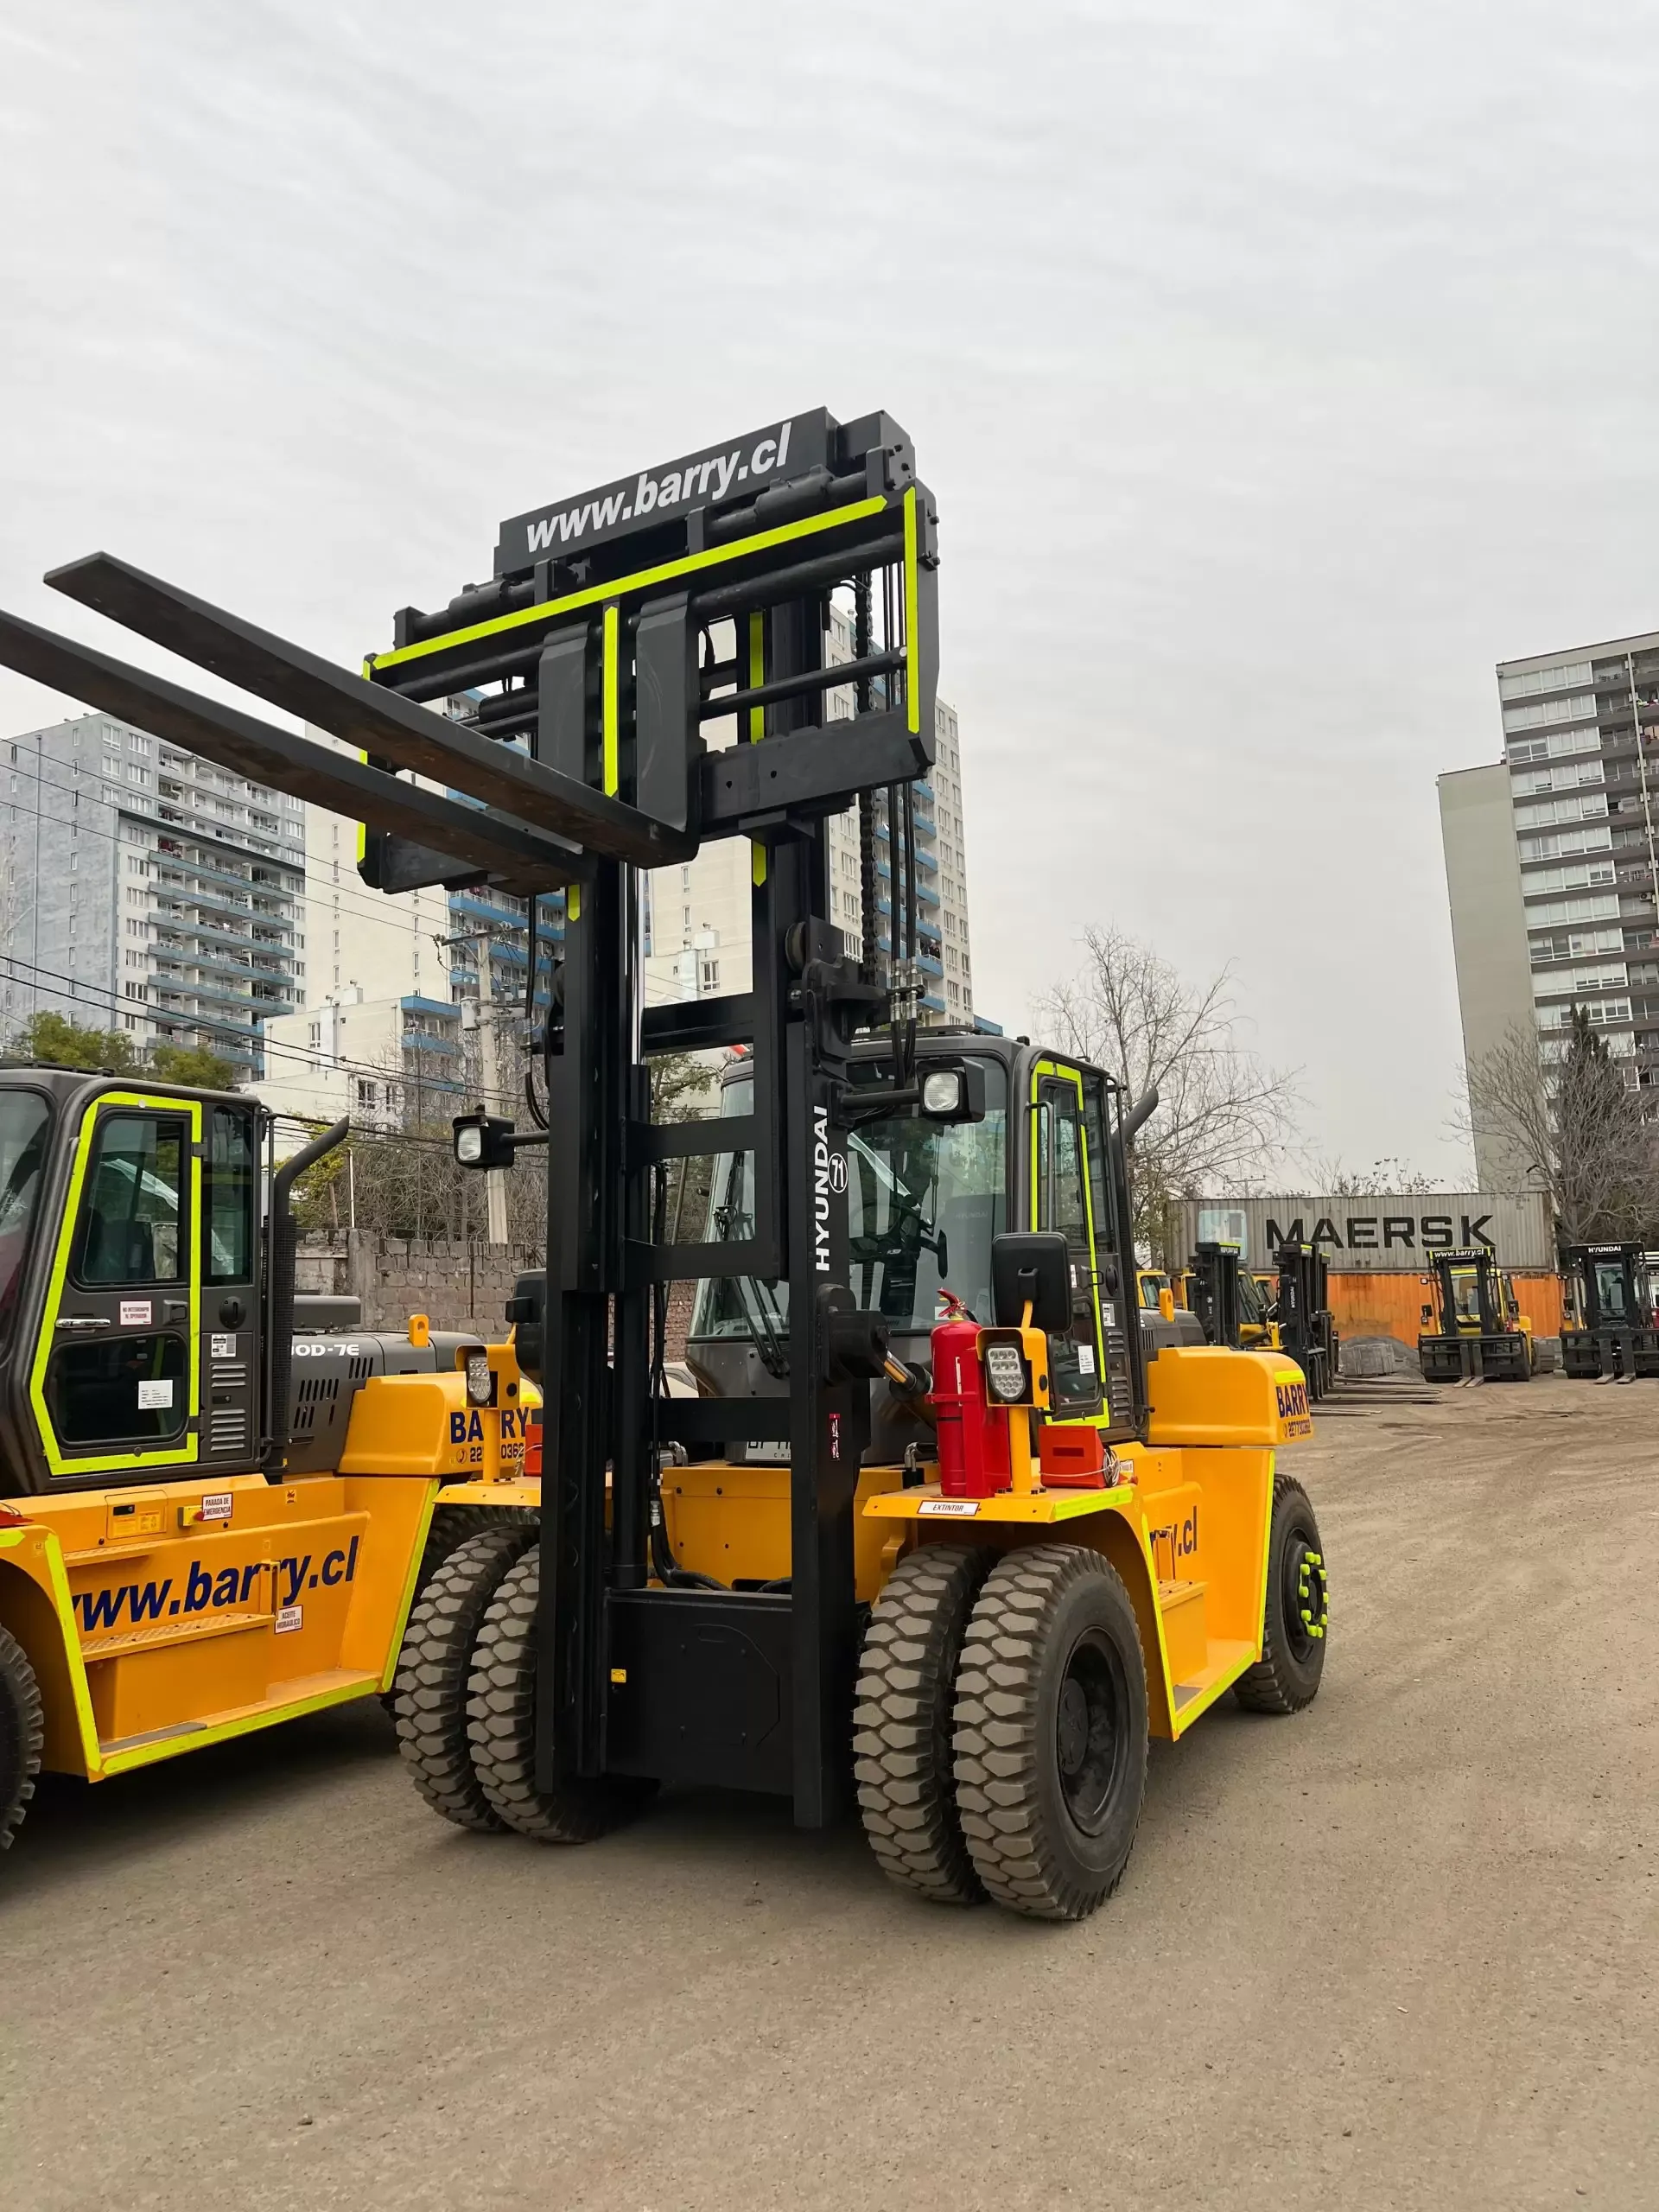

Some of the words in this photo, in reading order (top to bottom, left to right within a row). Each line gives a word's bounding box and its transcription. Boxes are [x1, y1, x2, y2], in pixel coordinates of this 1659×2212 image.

[526, 422, 793, 553] www.barry.cl
[814, 1105, 830, 1271] HYUNDAI
[831, 1159, 844, 1188] 71
[1265, 1214, 1497, 1249] MAERSK
[1434, 1248, 1484, 1258] www.barry.cl
[1588, 1245, 1622, 1254] HYUNDAI
[1275, 1382, 1310, 1418] BARRY
[449, 1406, 530, 1445] BARY
[932, 1503, 964, 1512] EXTINTOR
[71, 1535, 359, 1632] ww.bary.cl
